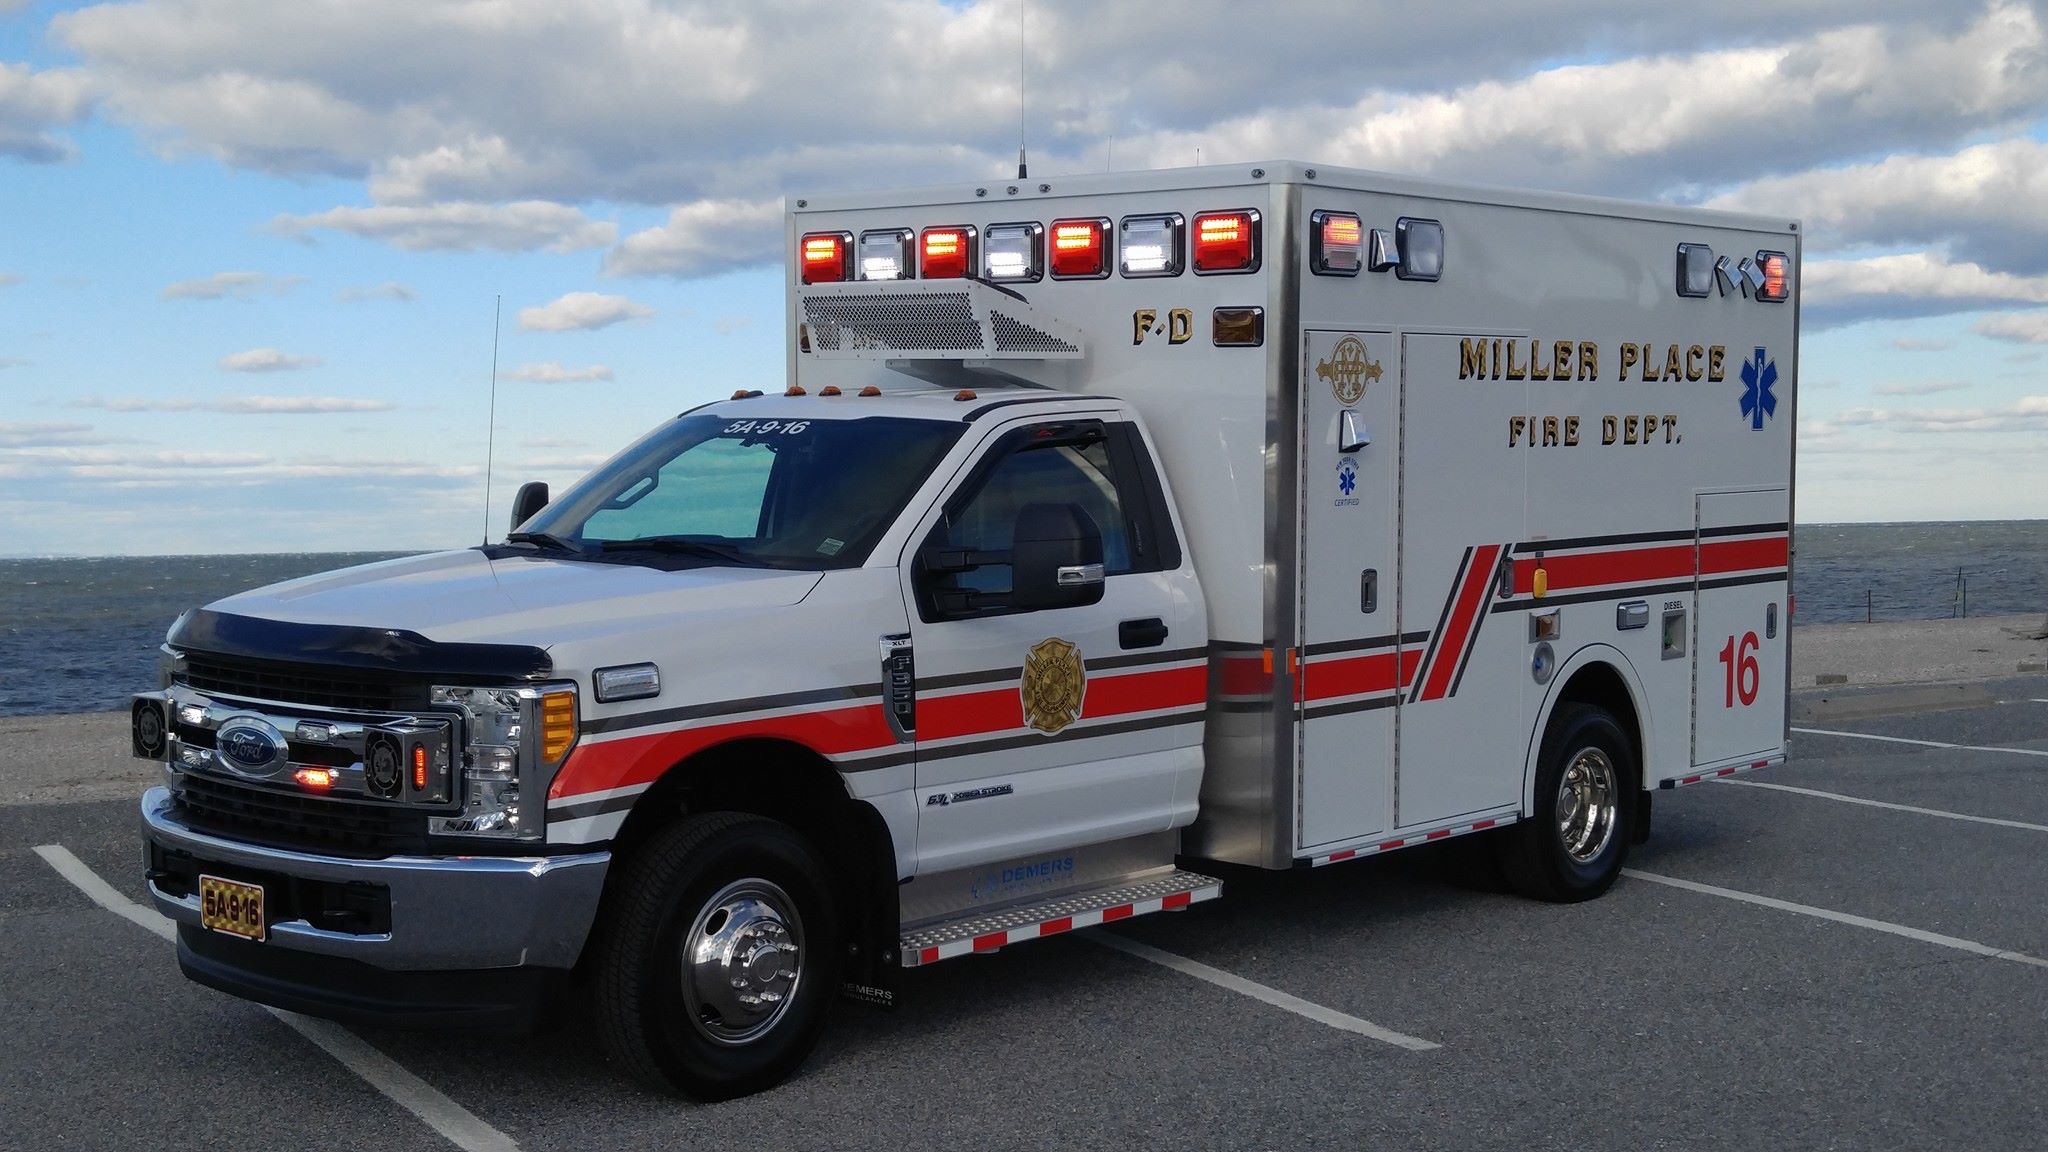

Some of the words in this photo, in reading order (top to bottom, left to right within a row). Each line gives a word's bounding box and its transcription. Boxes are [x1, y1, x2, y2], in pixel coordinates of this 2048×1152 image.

[1458, 337, 1599, 382] MILLER
[1618, 342, 1726, 383] PLACE
[1508, 415, 1581, 448] FIRE
[1601, 414, 1682, 446] DEPT.
[1663, 600, 1684, 611] DIESEL
[1719, 630, 1760, 709] 16
[229, 731, 265, 759] Ford
[952, 788, 981, 801] POWER
[981, 783, 1013, 797] STROKE
[1002, 856, 1074, 884] DEMERS
